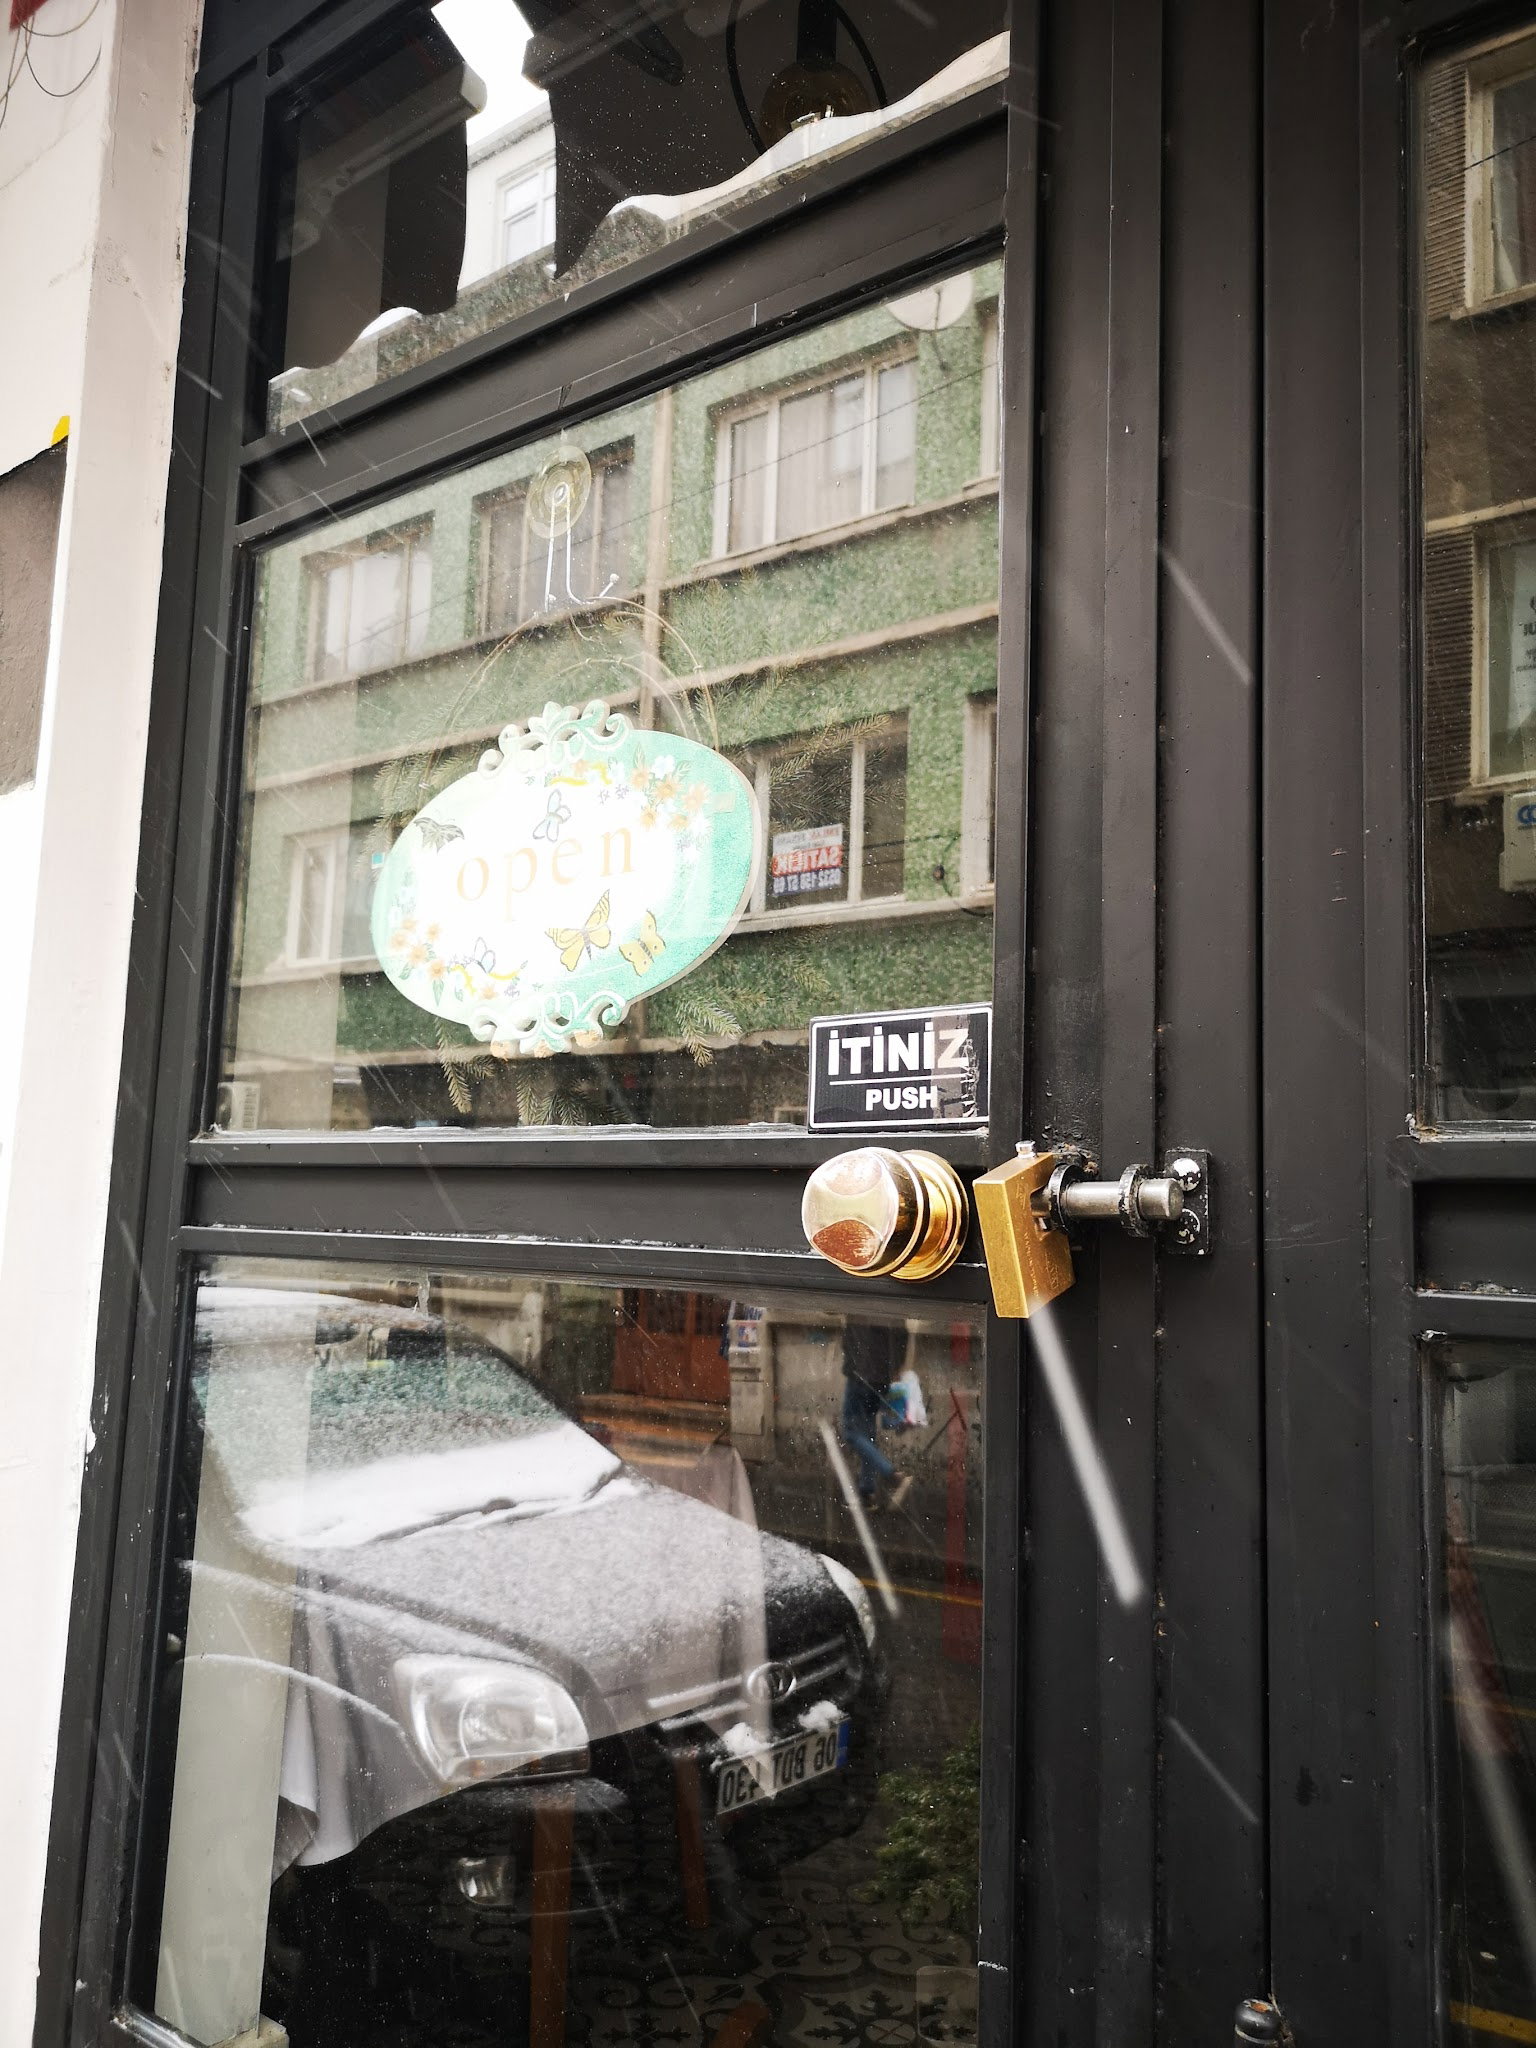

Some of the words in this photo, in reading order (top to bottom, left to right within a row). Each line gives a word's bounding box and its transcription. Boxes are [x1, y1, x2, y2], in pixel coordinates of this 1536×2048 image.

[457, 828, 633, 922] open
[827, 1021, 970, 1076] İTİNİZ
[865, 1085, 939, 1111] PUSH
